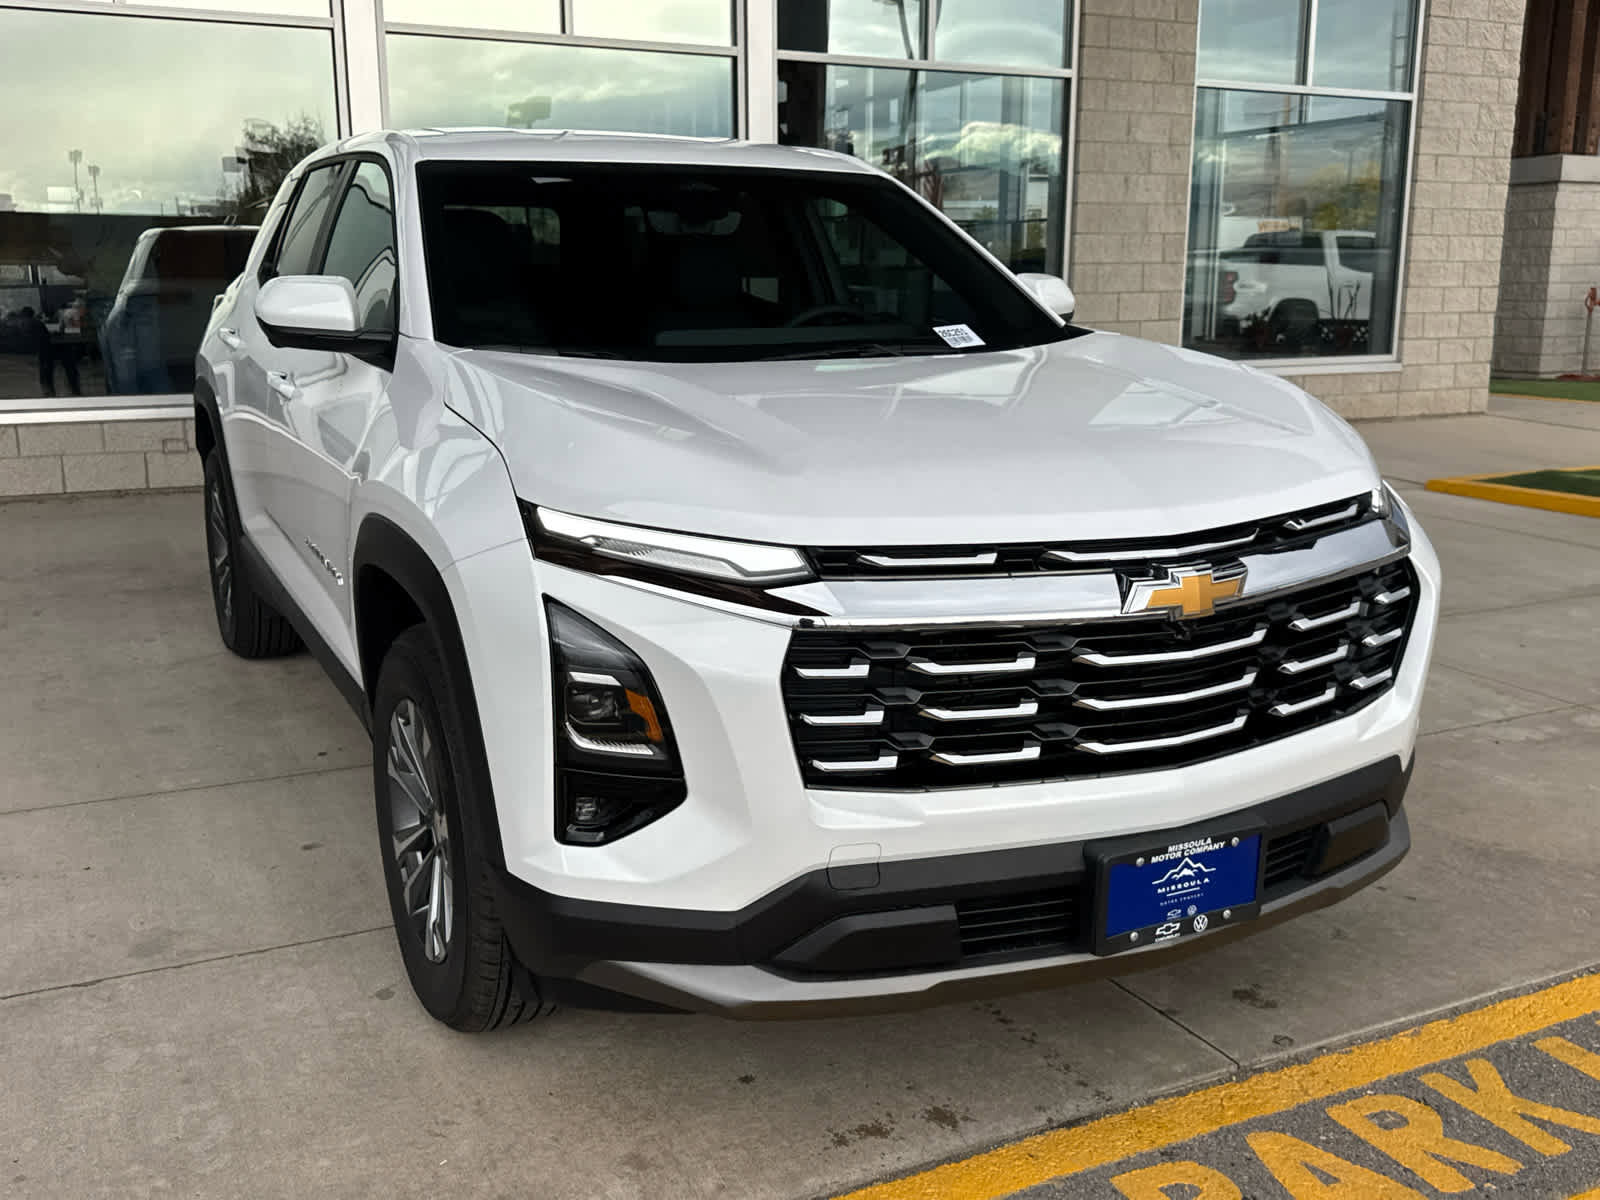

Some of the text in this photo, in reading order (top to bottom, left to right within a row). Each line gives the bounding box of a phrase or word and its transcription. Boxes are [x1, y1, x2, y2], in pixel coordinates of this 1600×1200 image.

[1151, 841, 1226, 863] MOTOR COMPANY
[1168, 837, 1212, 852] MISSOULA
[1157, 877, 1210, 894] MISSOULA
